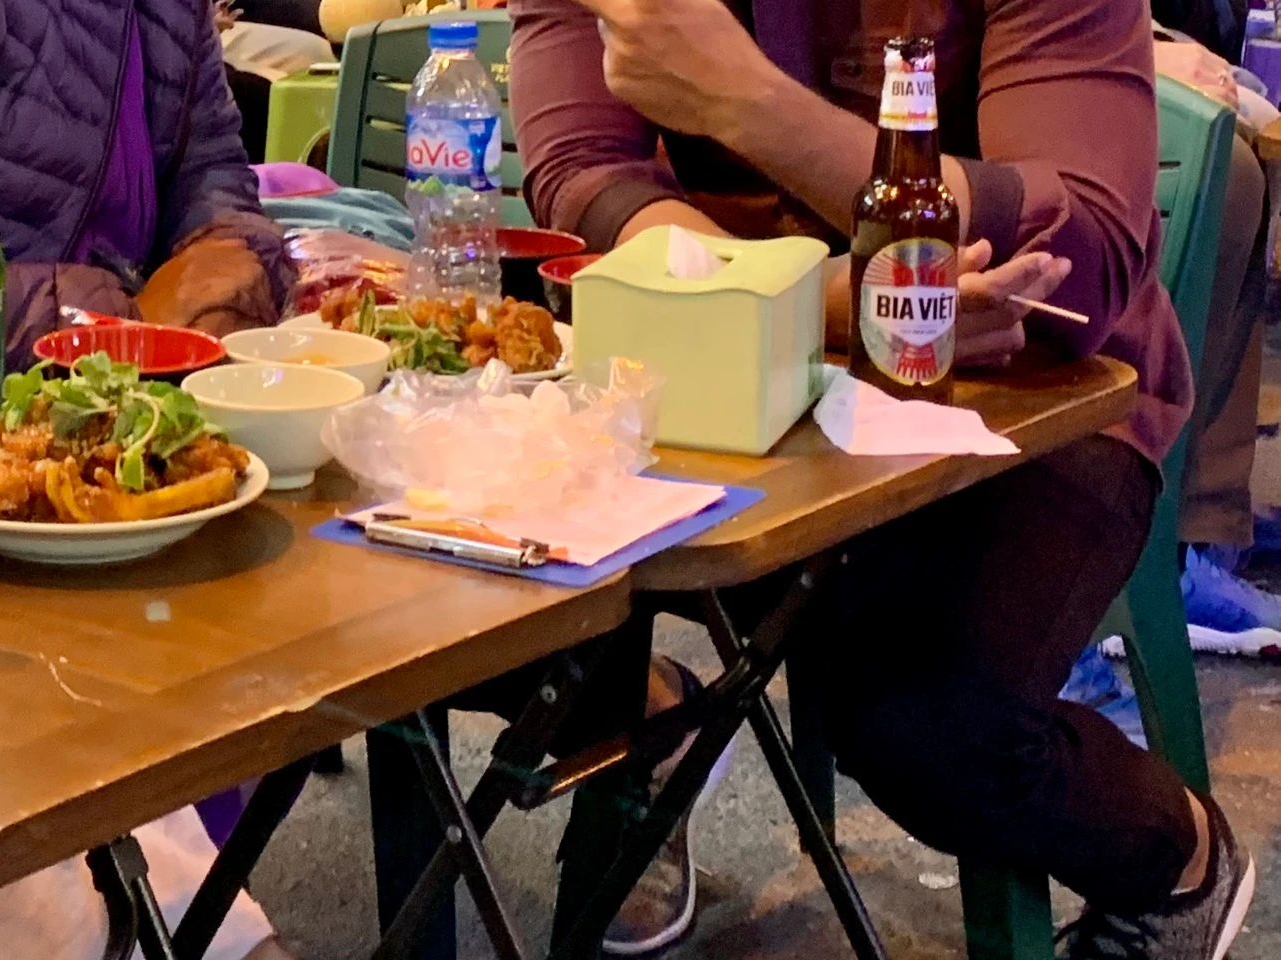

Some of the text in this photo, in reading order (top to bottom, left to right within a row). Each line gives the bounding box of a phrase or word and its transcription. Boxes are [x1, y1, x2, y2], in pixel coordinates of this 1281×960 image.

[892, 81, 914, 96] BIA
[408, 139, 469, 169] aVie
[876, 292, 954, 324] BIA VIỆT
